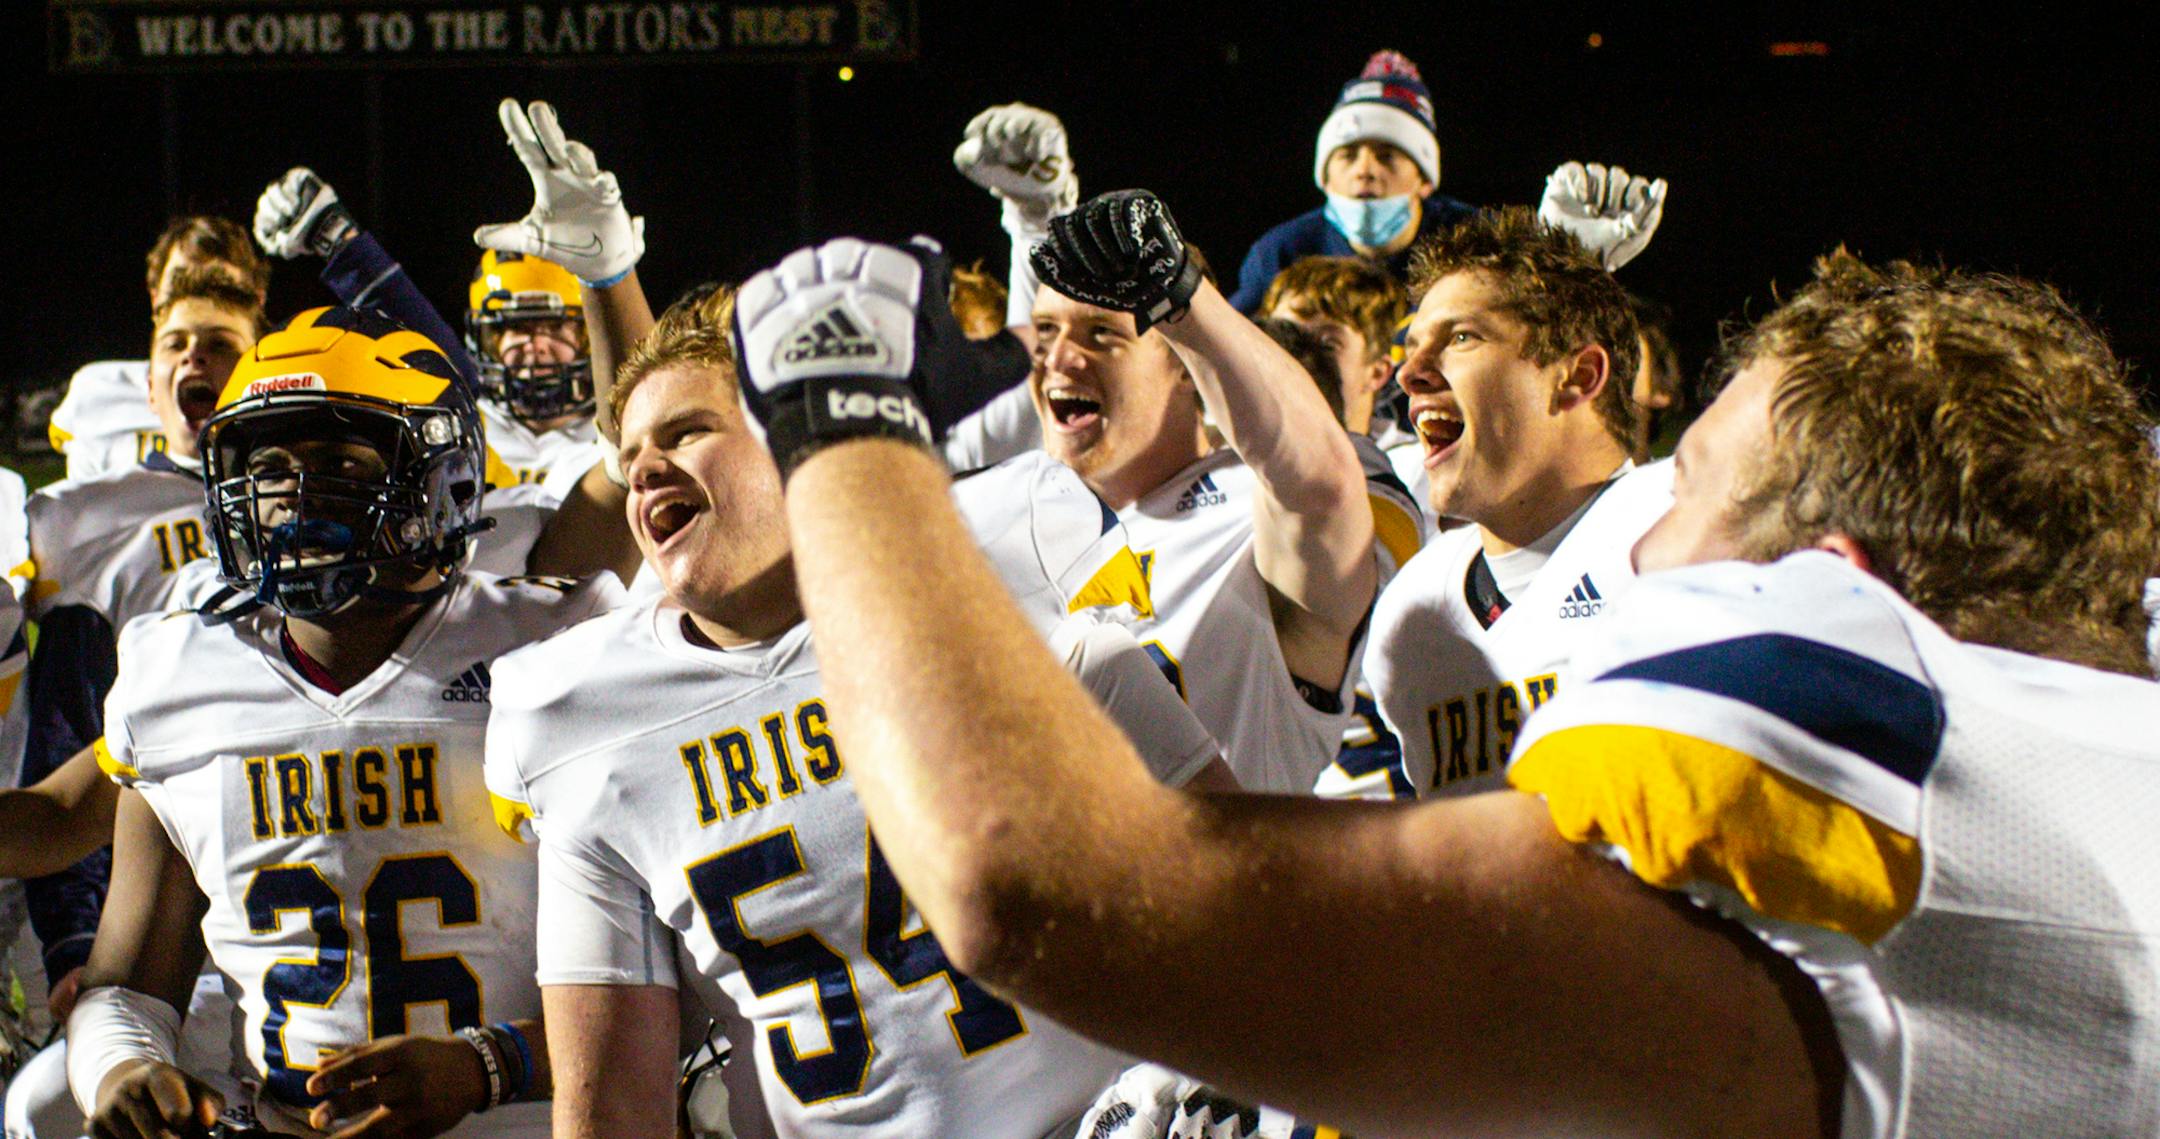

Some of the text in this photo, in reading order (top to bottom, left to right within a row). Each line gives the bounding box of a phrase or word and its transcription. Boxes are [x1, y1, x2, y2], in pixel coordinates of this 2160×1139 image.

[135, 12, 344, 57] WELCOME
[356, 11, 414, 52] TO
[425, 9, 509, 51] THE
[730, 6, 840, 46] NEST
[249, 375, 314, 396] Riddell
[1176, 493, 1228, 513] adidas
[244, 743, 443, 840] IRISH
[243, 851, 485, 1110] 26
[683, 822, 1030, 1108] 54
